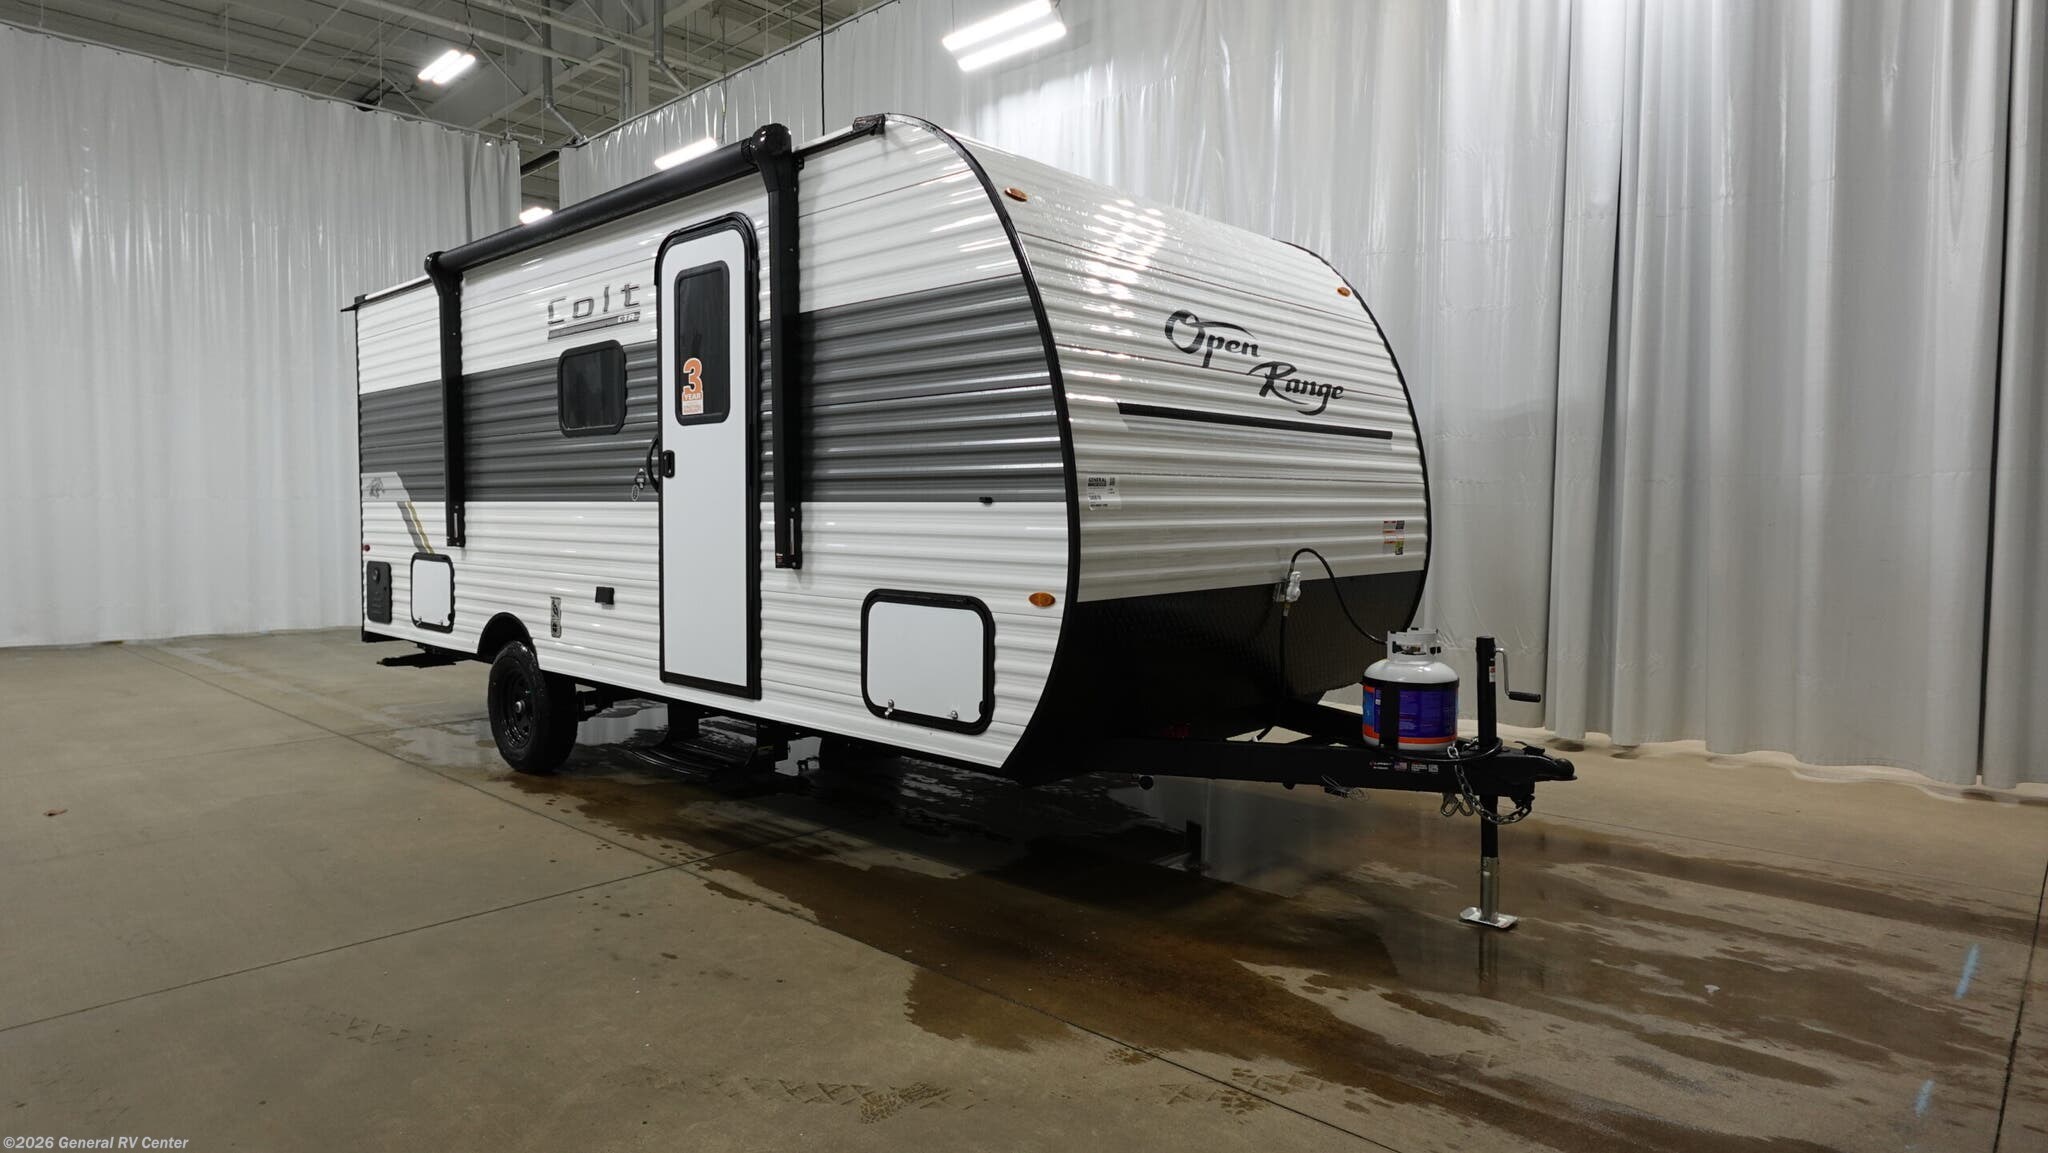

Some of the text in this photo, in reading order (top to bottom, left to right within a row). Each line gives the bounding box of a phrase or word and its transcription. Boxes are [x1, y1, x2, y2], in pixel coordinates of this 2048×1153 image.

[548, 284, 640, 324] Colt
[1165, 310, 1260, 368] Open
[683, 358, 703, 393] 3
[1247, 361, 1344, 415] Range
